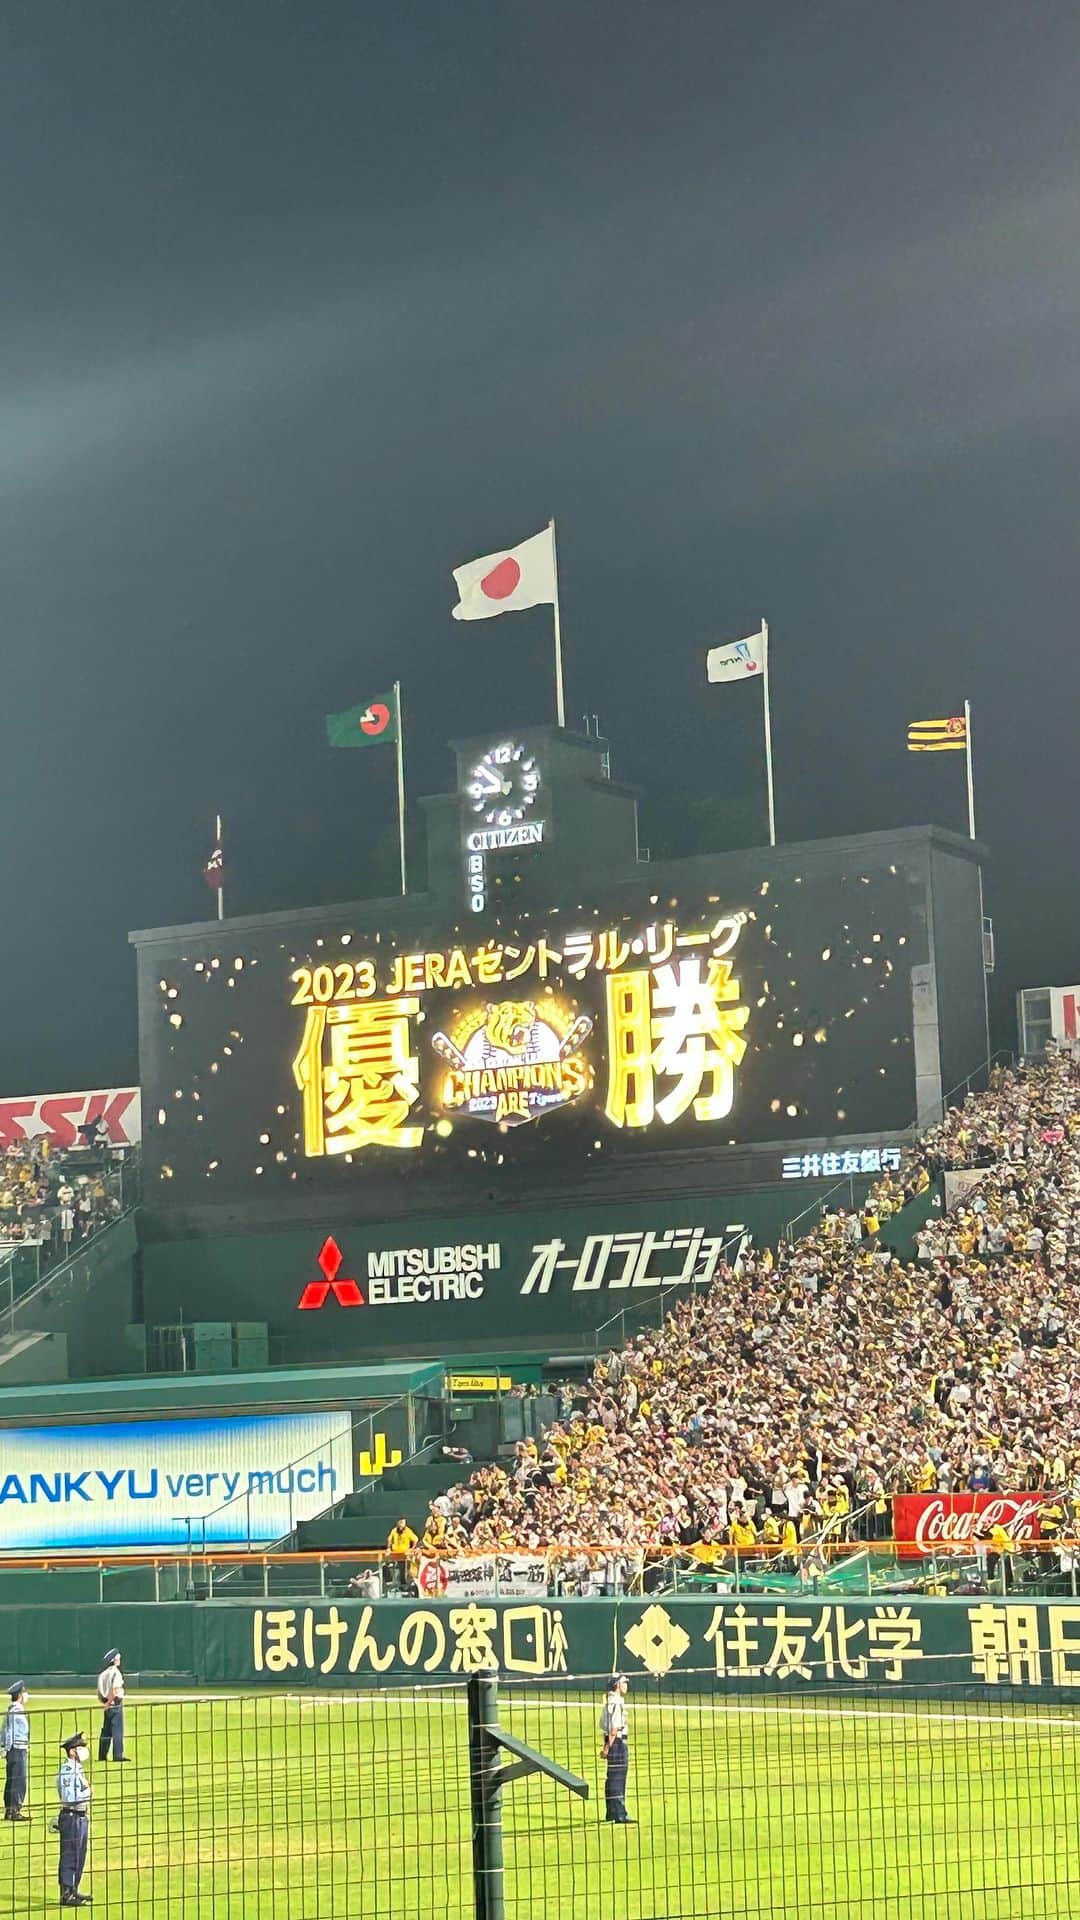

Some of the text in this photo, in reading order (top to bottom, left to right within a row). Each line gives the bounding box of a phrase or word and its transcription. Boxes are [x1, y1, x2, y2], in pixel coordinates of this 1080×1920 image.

[495, 748, 510, 764] 12
[468, 823, 545, 851] CITIZEN
[290, 961, 377, 1005] 2023
[443, 1057, 587, 1108] CHAMPIONS
[496, 1091, 531, 1122] ARE
[782, 1148, 901, 1178] 三井住友銀行
[368, 1243, 500, 1278] MITSUBISHI
[369, 1272, 484, 1305] ELECTRIC
[0, 1461, 337, 1503] ANKYU very much
[915, 1499, 1041, 1556] Coca-Cla
[253, 1603, 552, 1674] ほけんの窓口
[704, 1603, 923, 1680] 住友化学
